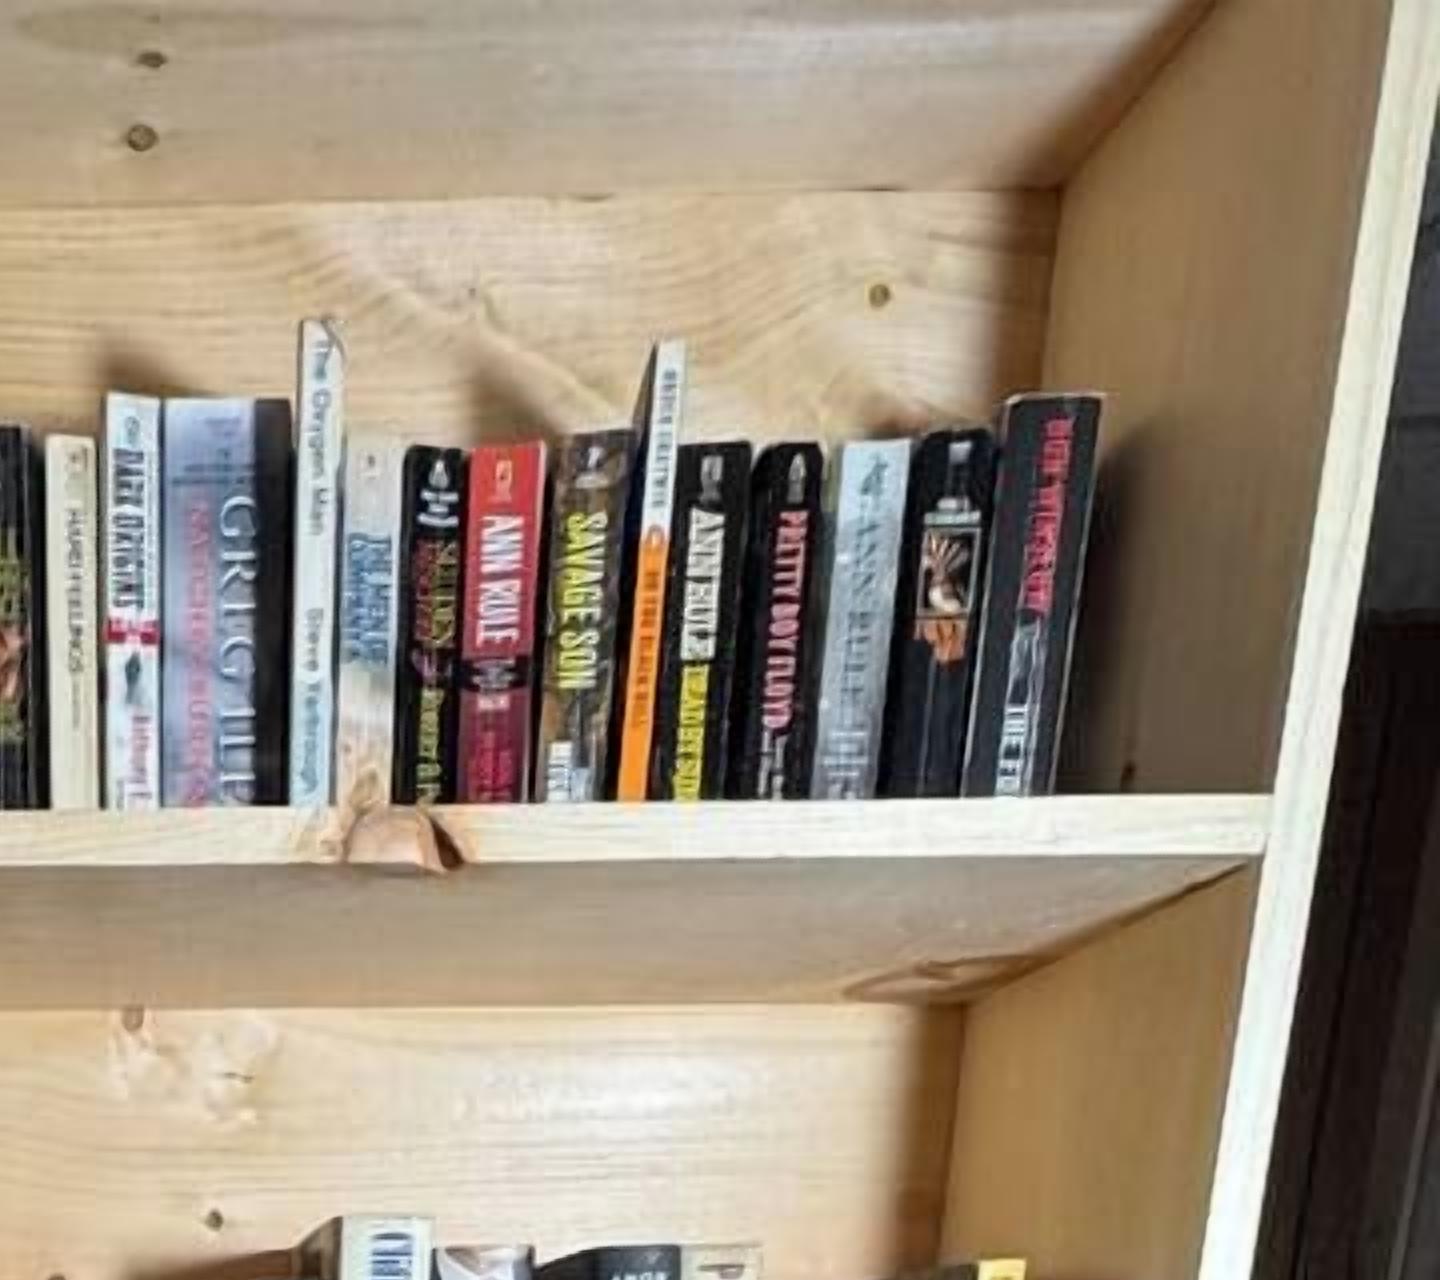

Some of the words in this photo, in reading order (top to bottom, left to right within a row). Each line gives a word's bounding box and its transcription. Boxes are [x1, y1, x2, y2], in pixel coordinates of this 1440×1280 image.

[110, 448, 146, 506] DARK
[481, 515, 525, 573] ANN
[561, 510, 608, 625] SAVAGE
[685, 508, 726, 577] ANN
[772, 509, 810, 598] PRETTY
[475, 580, 526, 646] RULE
[680, 580, 718, 661] RULE
[768, 602, 802, 650] BOY
[556, 629, 603, 690] SON
[760, 654, 796, 730] FLOYD
